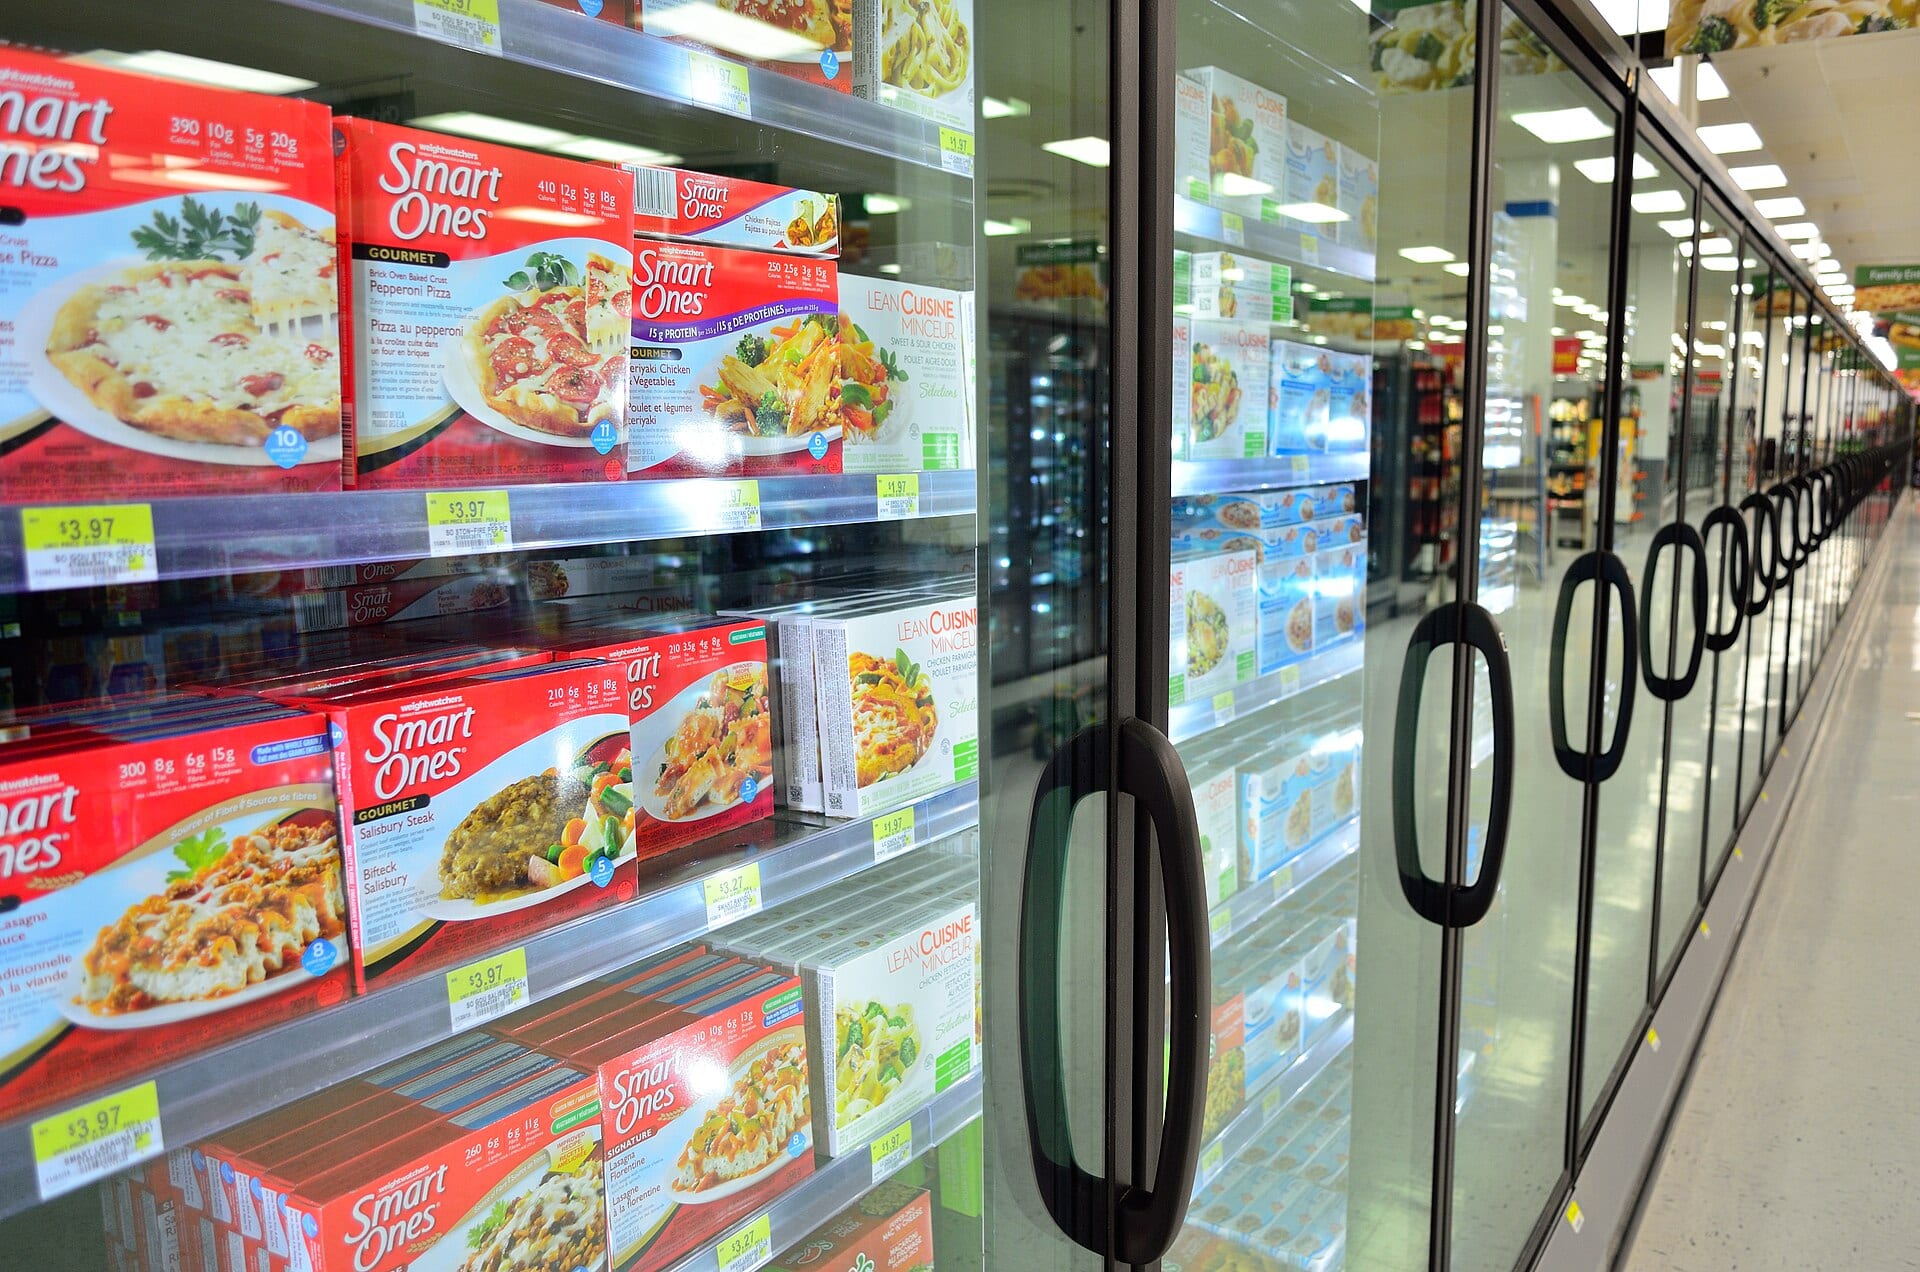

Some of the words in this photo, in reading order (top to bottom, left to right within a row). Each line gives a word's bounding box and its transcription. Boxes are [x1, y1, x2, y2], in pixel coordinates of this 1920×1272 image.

[826, 52, 832, 64] 7
[170, 117, 200, 136] 390
[208, 121, 234, 144] 10g
[246, 128, 265, 149] 5g
[270, 131, 298, 153] 20g
[949, 135, 967, 152] $1.97
[418, 142, 479, 161] weightwatchers
[378, 141, 503, 203] Smart
[538, 179, 556, 194] 410
[560, 183, 576, 201] 12g
[583, 187, 595, 204] 5g
[600, 190, 616, 207] 18g
[680, 177, 729, 204] Smart
[388, 191, 488, 241] Ones
[684, 198, 724, 220] Ones
[744, 214, 765, 226] Chicken
[765, 217, 782, 228] Fajitas
[744, 223, 761, 235] Fajitas
[768, 226, 786, 238] poulet
[20, 245, 59, 267] Pizza
[368, 247, 436, 266] GOURMET
[658, 246, 705, 258] weightwatchers
[369, 268, 387, 279] Brick
[388, 270, 407, 281] Oven
[408, 271, 428, 283] Baked
[429, 274, 448, 285] Crust
[633, 249, 715, 288] Smart
[767, 261, 781, 273] 250
[801, 264, 812, 278] 3g
[815, 266, 827, 280] 15g
[1869, 269, 1903, 282] Family
[370, 280, 423, 299] Pepperoni
[426, 285, 451, 300] Pizza
[639, 282, 703, 320] Ones
[866, 289, 899, 312] LEAN
[900, 289, 956, 319] CUISINE
[370, 318, 397, 333] Pizza
[399, 323, 412, 334] au
[415, 325, 464, 337] pepperoni
[649, 327, 657, 338] 15
[665, 326, 698, 339] PROTEIN
[733, 314, 745, 328] DE
[744, 303, 785, 325] PROTÉINES
[901, 317, 956, 340] MINCEUR
[376, 337, 383, 345] la
[407, 340, 423, 348] cuite
[424, 340, 439, 348] dans
[381, 346, 396, 356] four
[406, 349, 430, 359] briques
[890, 336, 910, 347] SWEET
[916, 338, 932, 349] SOUR
[932, 340, 956, 352] CHICKEN
[630, 348, 672, 358] OURMET
[903, 354, 924, 364] POULET
[629, 363, 657, 374] eriyaki
[659, 363, 691, 375] Chicken
[633, 375, 676, 388] Vegetables
[654, 402, 663, 413] et
[663, 402, 693, 415] légumes
[274, 430, 298, 447] 10
[600, 424, 610, 436] 11
[815, 435, 821, 447] 6
[887, 480, 906, 494] $1.97
[449, 501, 486, 518] $3.97
[59, 517, 115, 541] $3.97
[363, 562, 396, 581] Ones
[350, 591, 393, 611] Smart
[354, 605, 388, 623] Ones
[897, 620, 929, 643] LEAN
[608, 645, 650, 658] weightwatchers
[669, 643, 681, 655] 210
[699, 638, 709, 650] 4g
[711, 636, 721, 648] 8g
[627, 652, 662, 683] art
[926, 656, 951, 669] CHICKEN
[931, 666, 951, 679] POULET
[548, 687, 564, 701] 210
[568, 685, 580, 699] 6g
[587, 681, 599, 695] 5g
[603, 678, 617, 692] 18g
[400, 695, 463, 714] weightwatchers
[364, 706, 477, 765] Smart
[119, 761, 146, 780] 300
[153, 758, 175, 775] 8g
[185, 752, 206, 769] 6g
[211, 747, 236, 762] 15g
[374, 749, 462, 801] Ones
[745, 781, 752, 790] 5
[0, 785, 80, 838] art
[169, 819, 203, 841] Source
[204, 812, 214, 824] of
[214, 804, 239, 819] Fibre
[246, 794, 278, 809] Source
[279, 793, 291, 803] de
[292, 791, 318, 802] fibres
[358, 797, 416, 822] GOURMET
[360, 820, 404, 840] Salisbury
[406, 811, 435, 827] Steak
[884, 816, 903, 833] $1.97
[363, 861, 397, 881] Bifteck
[597, 860, 606, 873] 5
[364, 874, 408, 896] Salisbury
[719, 875, 743, 895] $3.27
[312, 943, 324, 958] 8
[886, 941, 920, 974] LEAN
[919, 914, 972, 956] CUISINE
[921, 934, 972, 978] MINCEUR
[10, 981, 21, 994] la
[26, 969, 69, 990] viande
[469, 964, 503, 988] $3.97
[918, 971, 943, 990] CHICKEN
[692, 1030, 706, 1044] 310
[709, 1025, 723, 1037] 10g
[727, 1018, 738, 1029] 6g
[740, 1011, 753, 1023] 13g
[608, 1051, 684, 1111] Smart
[615, 1084, 675, 1136] Ones
[67, 1104, 121, 1140] $3.97
[465, 1143, 482, 1160] 260
[487, 1136, 500, 1150] 6g
[507, 1127, 521, 1140] 6g
[525, 1117, 539, 1130] 11g
[556, 1131, 586, 1150] IMPROVED
[607, 1128, 653, 1158] SIGNATURE
[793, 1134, 800, 1145] 8
[882, 1137, 899, 1152] $1.97
[609, 1151, 636, 1172] Lasagna
[610, 1156, 646, 1183] Florentine
[378, 1163, 430, 1194] weightwatchers
[345, 1163, 449, 1245] Smart
[612, 1185, 639, 1206] Lasagne
[619, 1204, 626, 1214] la
[627, 1184, 661, 1210] florentine
[353, 1205, 437, 1272] Ones
[731, 1230, 755, 1252] $3.27
